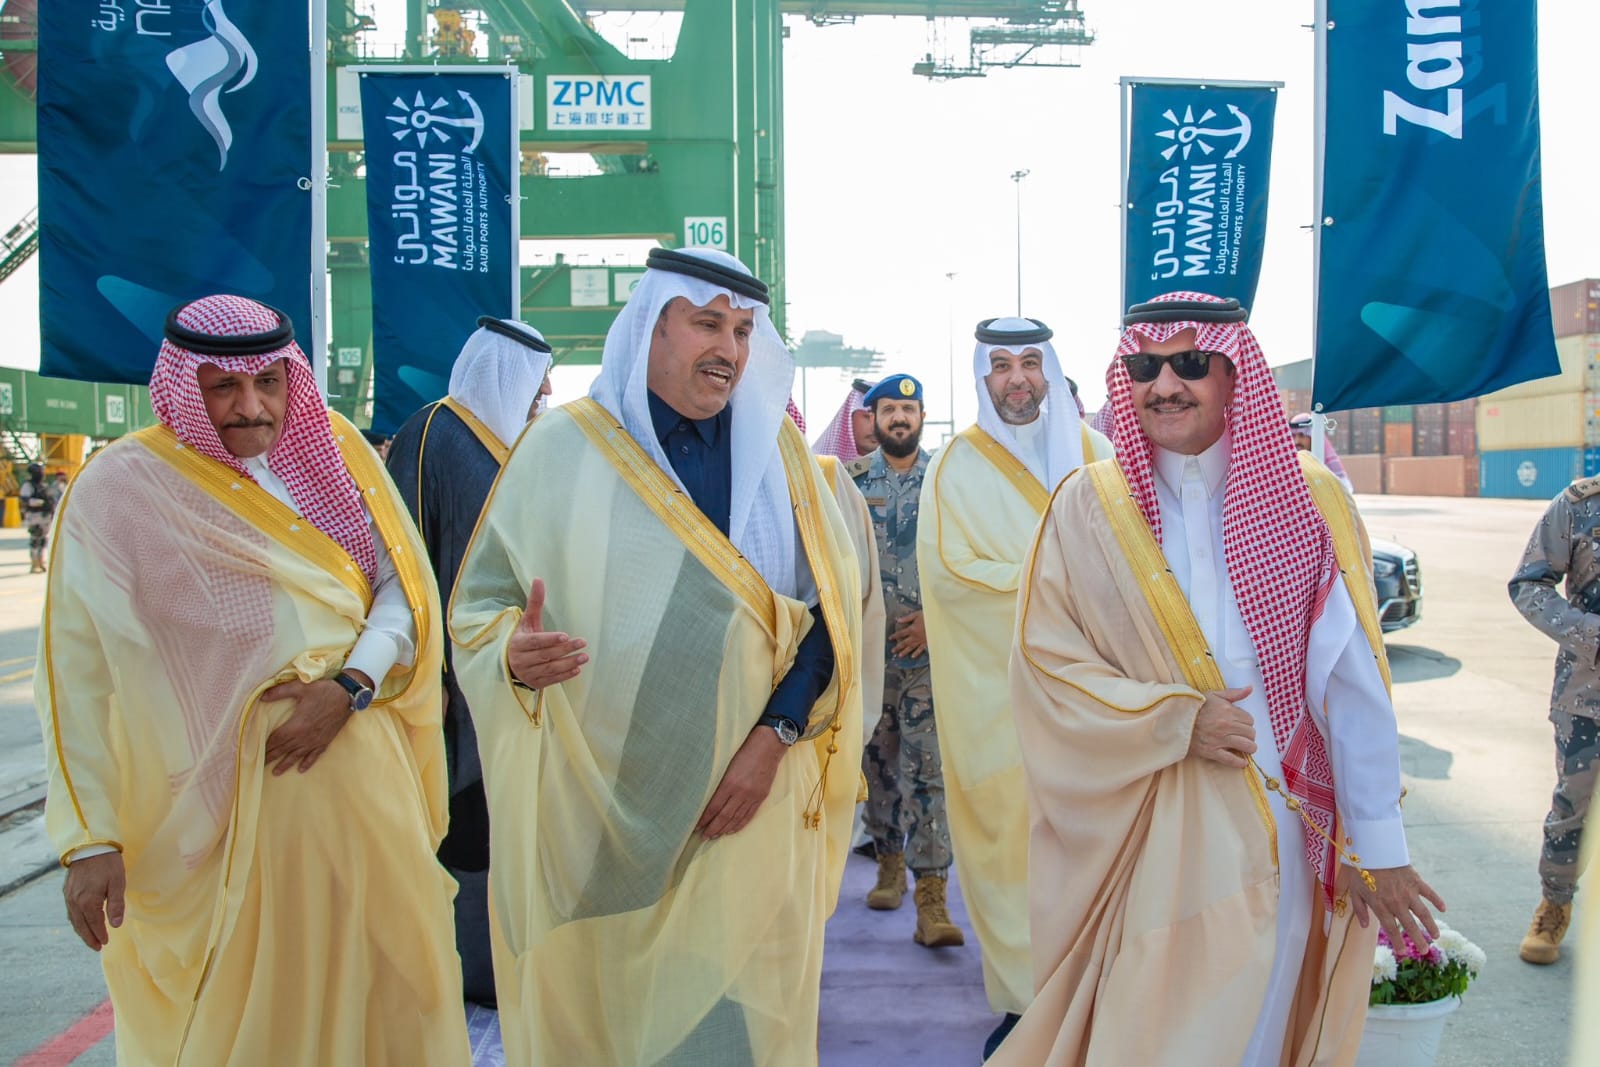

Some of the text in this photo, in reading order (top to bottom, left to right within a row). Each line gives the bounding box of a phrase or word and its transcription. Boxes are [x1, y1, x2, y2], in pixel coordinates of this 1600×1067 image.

[553, 81, 645, 106] ZPMC
[553, 112, 646, 125] 上海振华重工
[461, 155, 474, 190] الهيئة
[1219, 162, 1233, 195] الهيئة
[428, 153, 458, 269] MAWANI
[462, 190, 474, 224] العامة
[476, 161, 489, 273] SAUDI PORTS AUTHORITY
[1182, 163, 1217, 277] MAWANI
[1218, 197, 1230, 229] العامة
[1229, 164, 1247, 276] SAUDI PORTS AUTHORITY
[688, 222, 724, 245] 106
